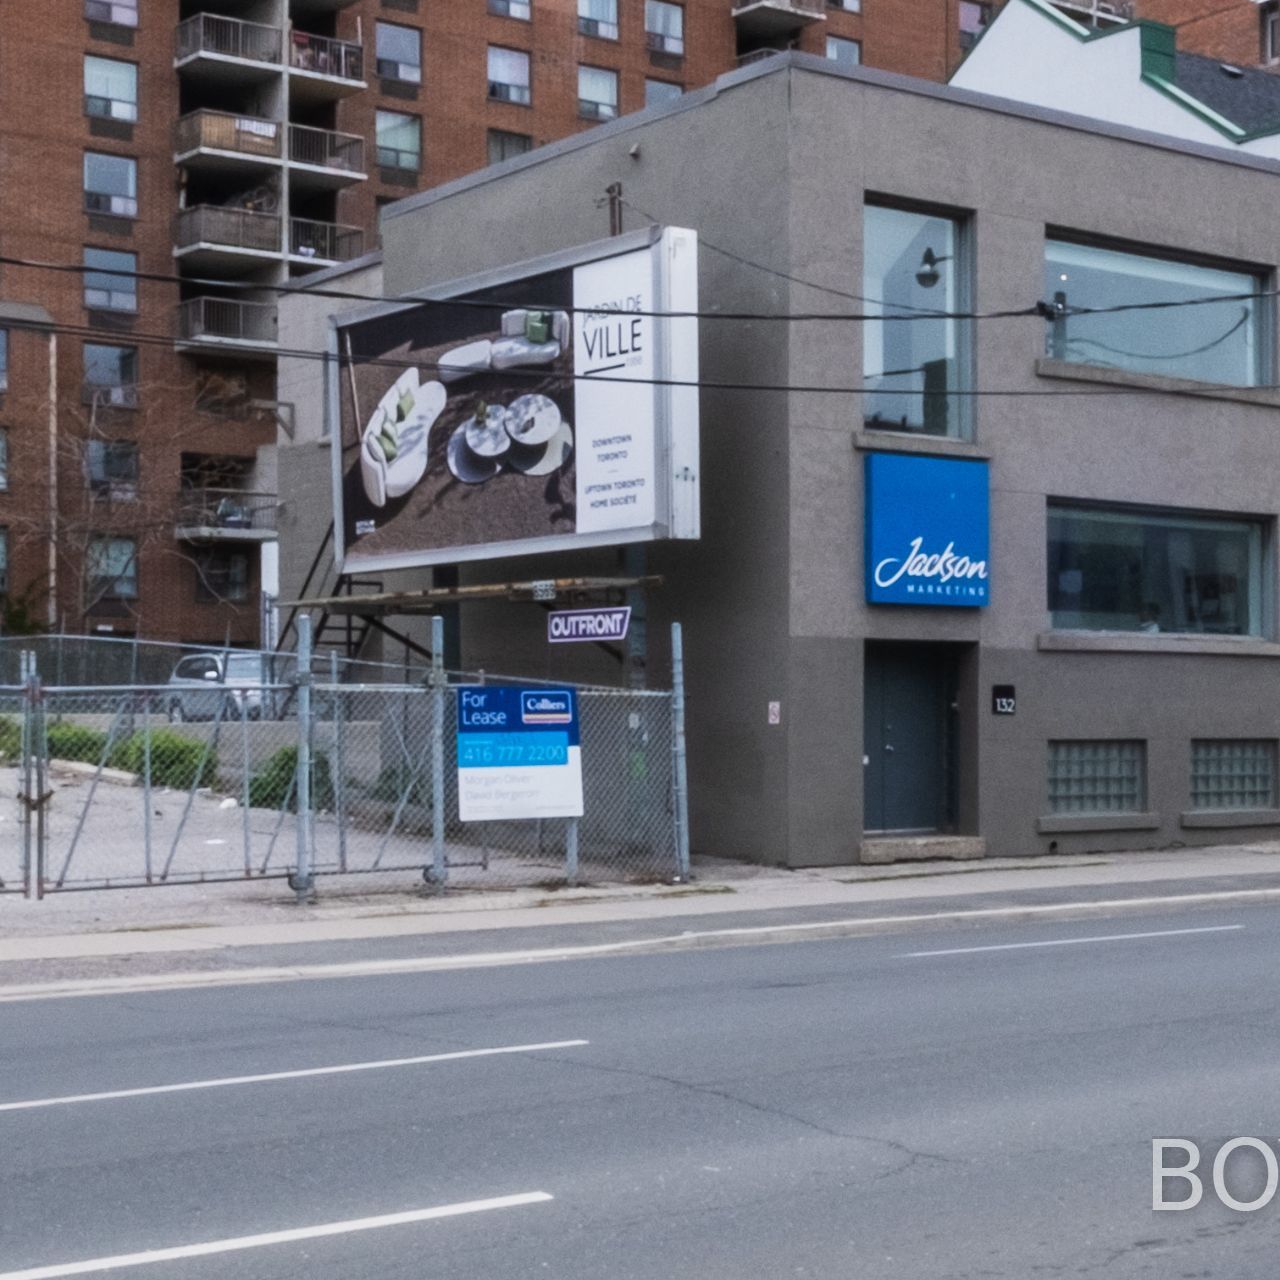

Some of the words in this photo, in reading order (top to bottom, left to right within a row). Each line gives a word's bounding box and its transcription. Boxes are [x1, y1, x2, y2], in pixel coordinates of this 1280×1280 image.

[583, 319, 642, 359] VILLE
[592, 434, 632, 448] DOWNTOWN
[597, 450, 628, 462] TORONTO
[613, 478, 645, 490] TORONTO
[875, 536, 988, 587] Jackson
[907, 585, 985, 596] MARKETING
[551, 613, 623, 636] OUTFRONT
[462, 691, 487, 707] For
[526, 698, 566, 710] Colliers
[996, 698, 1015, 712] 132
[463, 709, 507, 725] Lease
[464, 746, 493, 761] 416
[497, 746, 524, 761] 777
[528, 745, 565, 761] 2200
